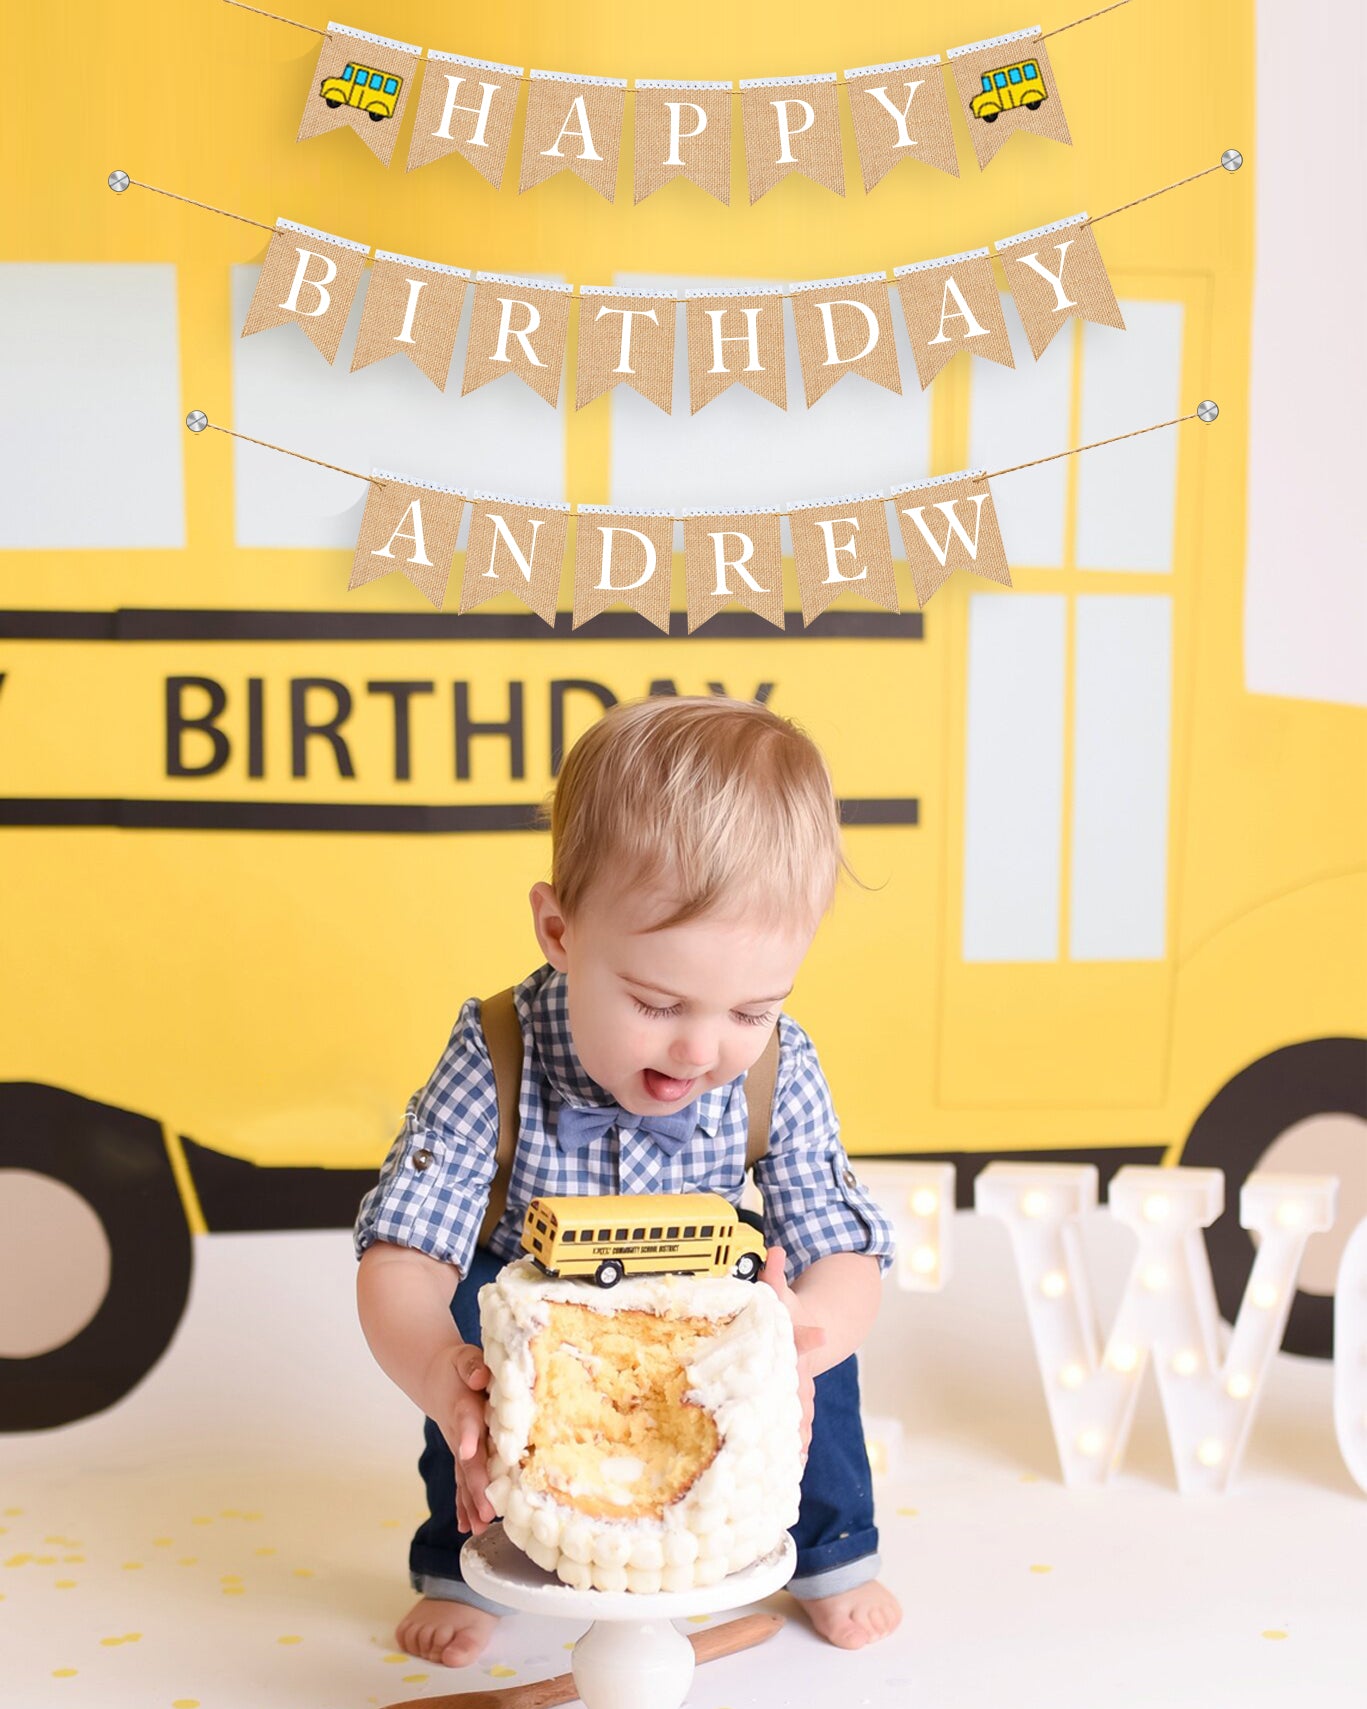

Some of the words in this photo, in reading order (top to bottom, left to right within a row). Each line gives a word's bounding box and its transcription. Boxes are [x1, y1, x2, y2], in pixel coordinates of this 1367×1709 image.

[431, 74, 926, 166] HAPPY
[277, 240, 1078, 374] BIRTHDAY
[370, 493, 991, 597] ANDREW
[165, 674, 775, 784] BIRTHD
